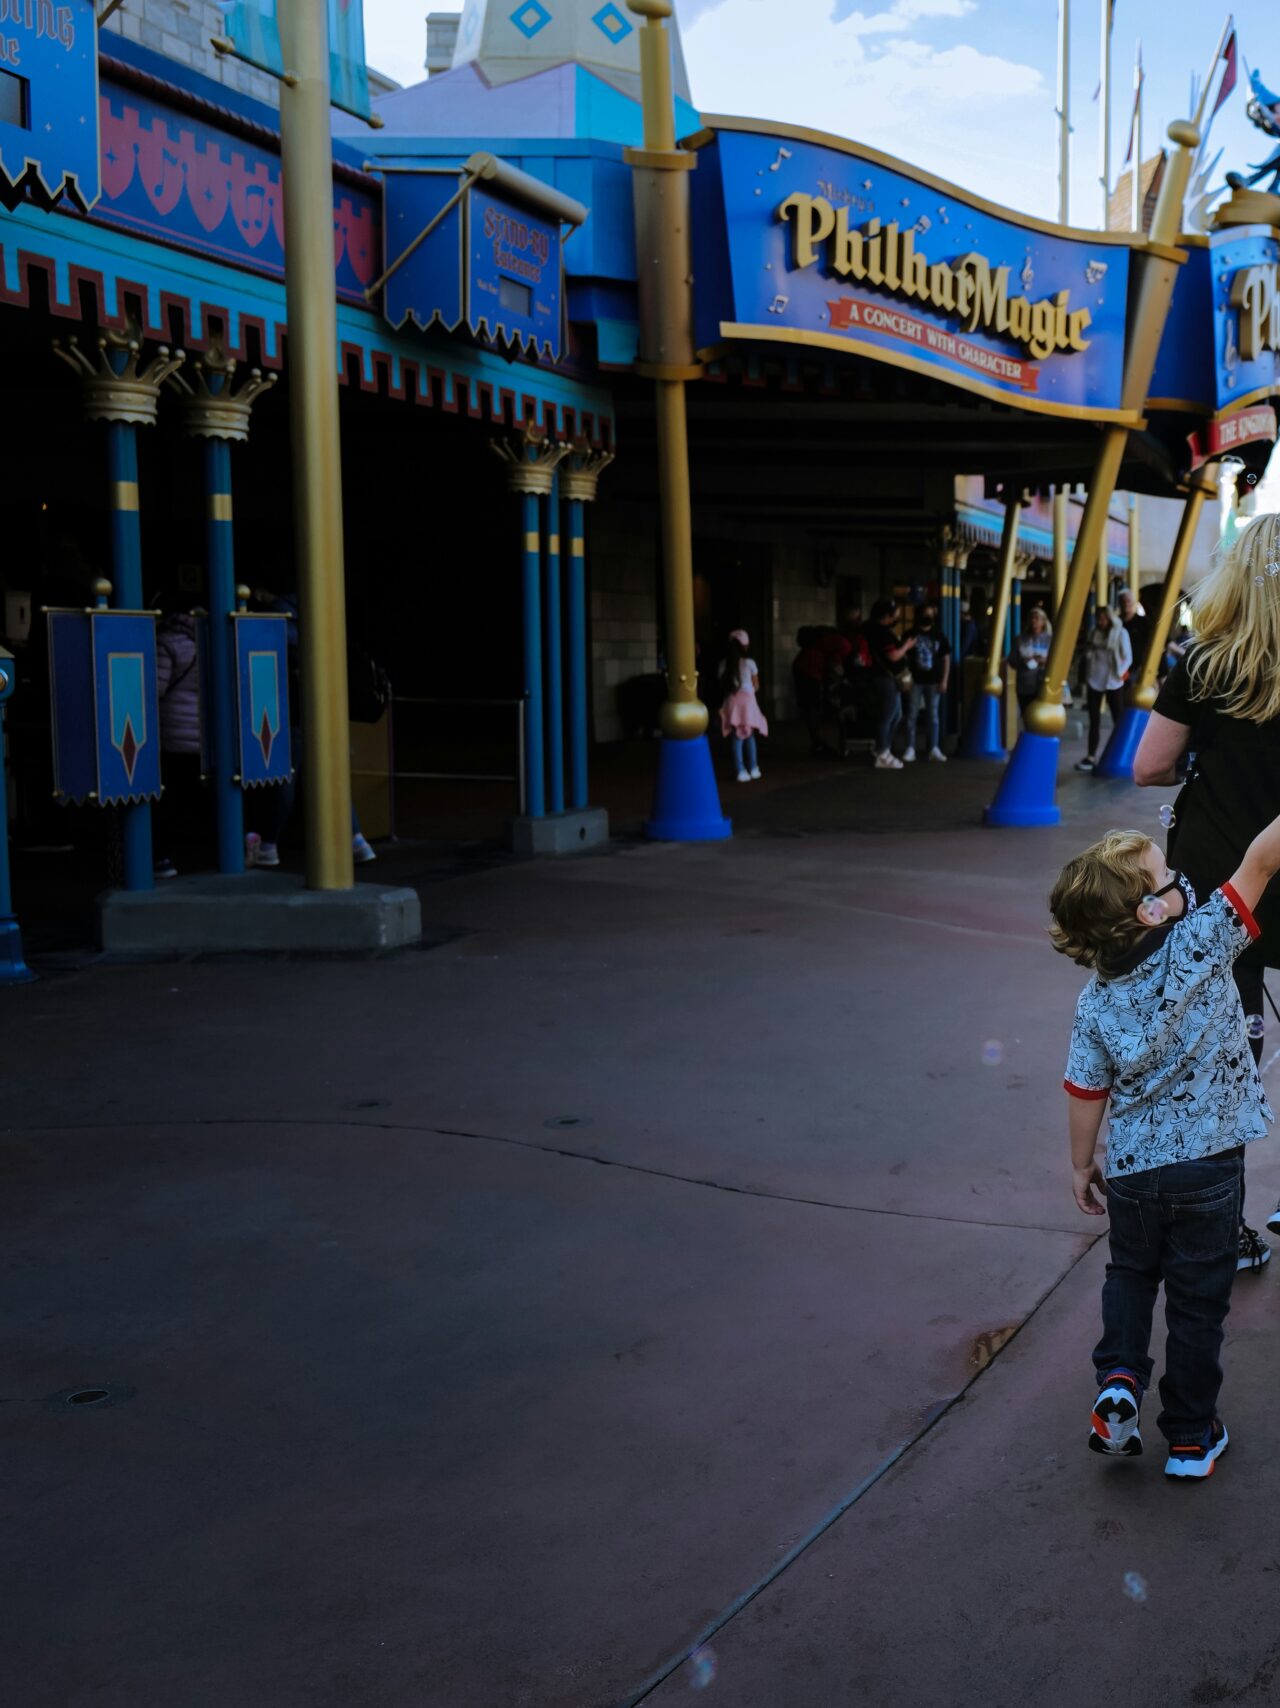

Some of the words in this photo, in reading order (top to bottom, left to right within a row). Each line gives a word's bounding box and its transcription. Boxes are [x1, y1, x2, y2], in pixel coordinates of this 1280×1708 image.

[779, 191, 1093, 361] PhilharMagic
[850, 304, 860, 321] A
[863, 306, 923, 341] CONCERT
[926, 329, 956, 354] WITH
[957, 343, 1022, 379] CHARACTER
[1220, 420, 1237, 445] THE
